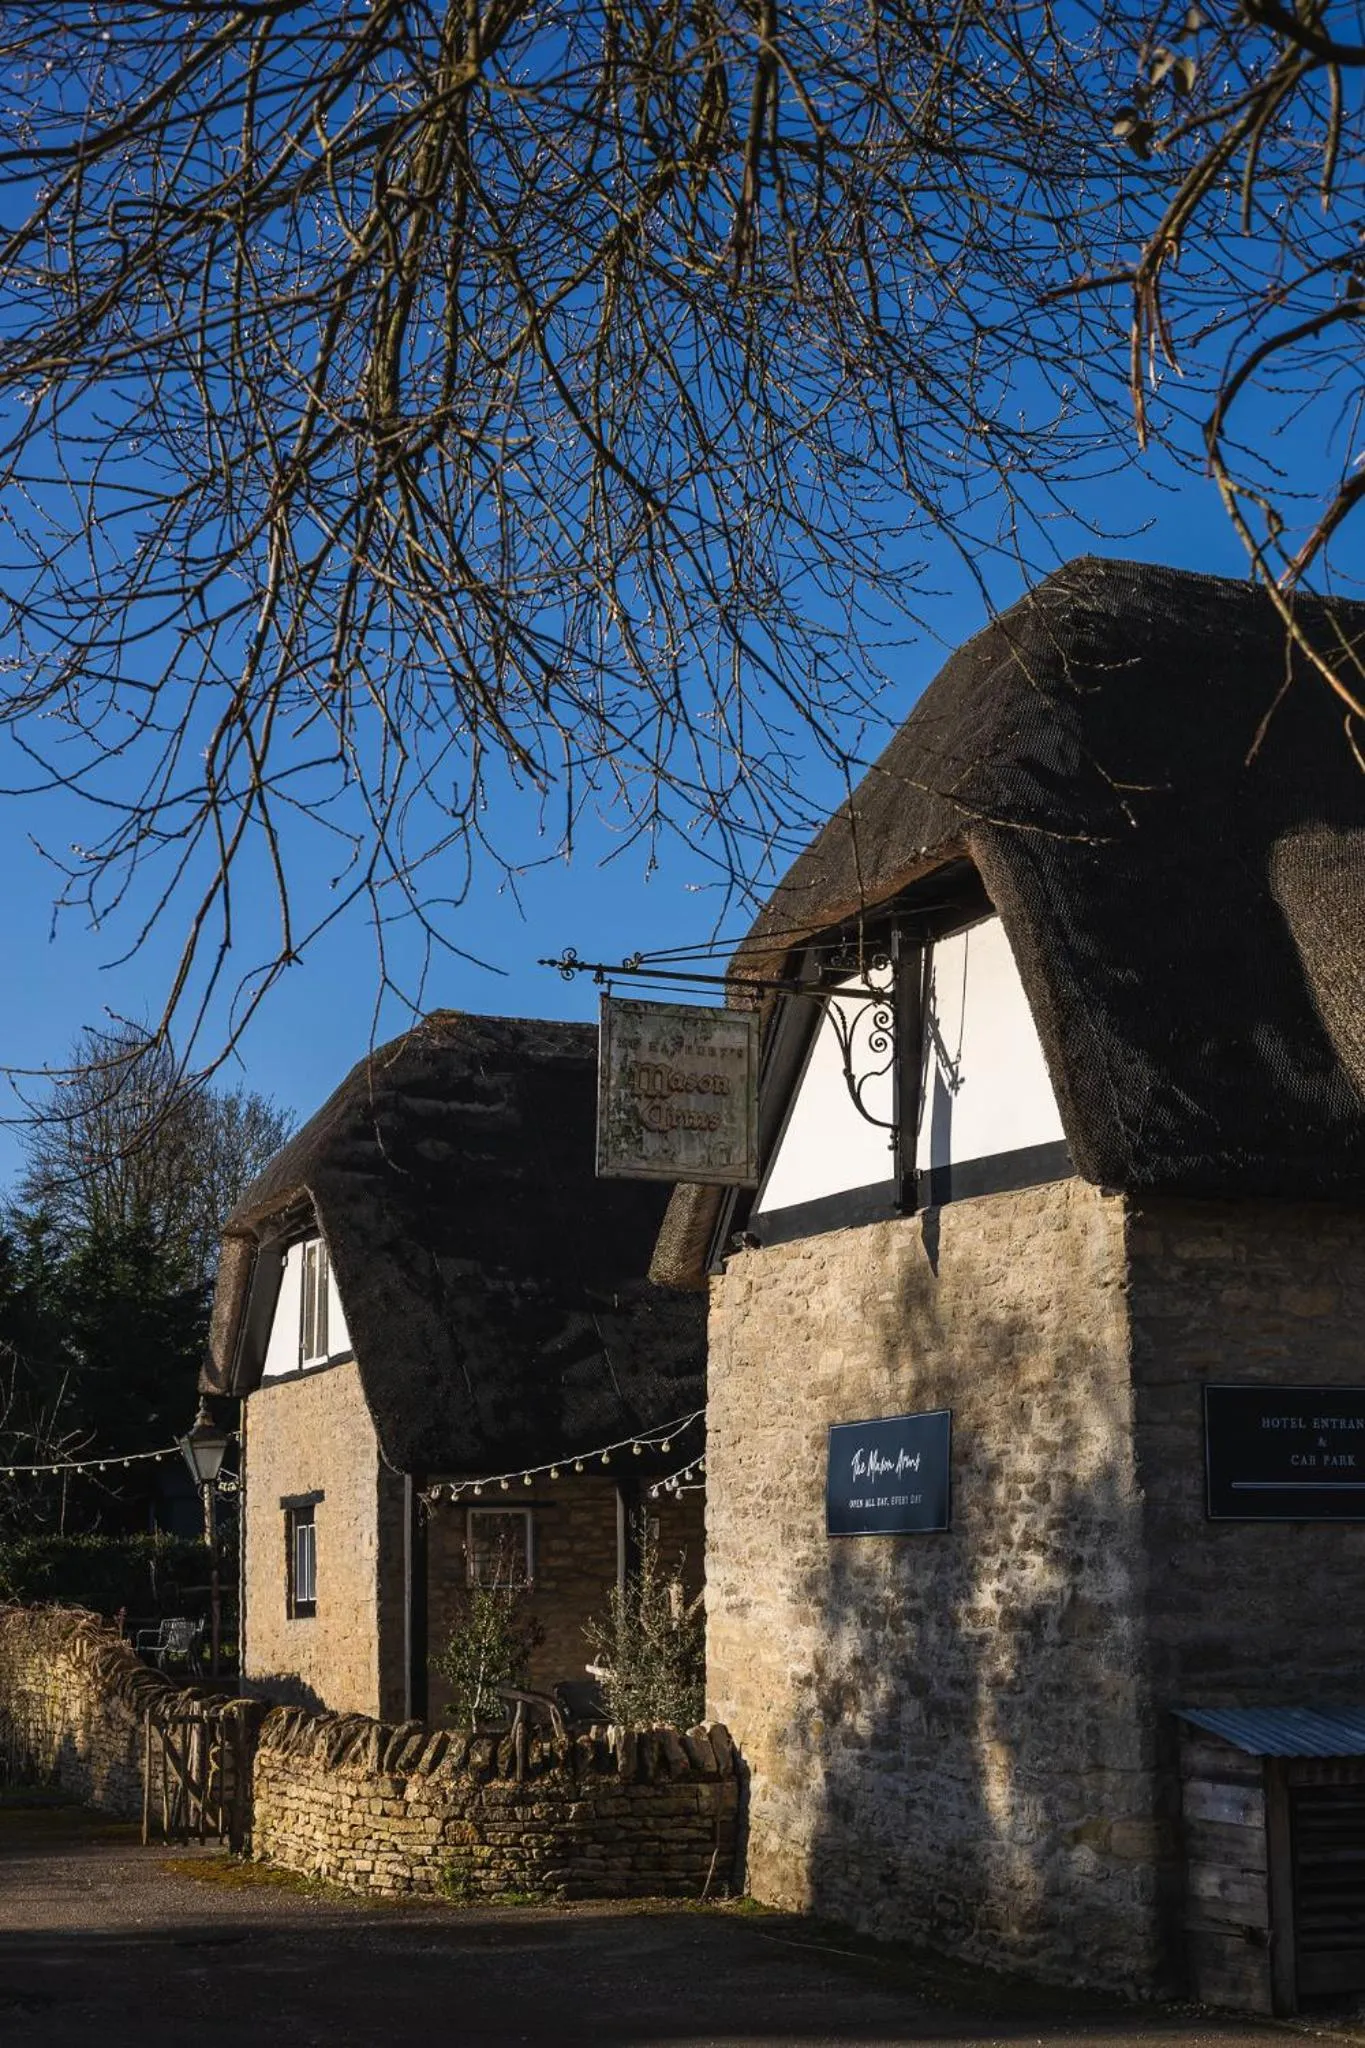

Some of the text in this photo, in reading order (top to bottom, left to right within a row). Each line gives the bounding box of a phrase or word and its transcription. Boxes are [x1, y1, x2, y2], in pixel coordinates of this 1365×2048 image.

[631, 1061, 730, 1099] Mason
[1261, 1416, 1307, 1429] HOTEL
[1317, 1435, 1328, 1448] &
[851, 1447, 921, 1483] The Mason Arms
[1290, 1454, 1356, 1467] CAR PARK
[849, 1499, 863, 1508] OPEN
[865, 1497, 876, 1507] ALL
[891, 1495, 909, 1505] EVERY
